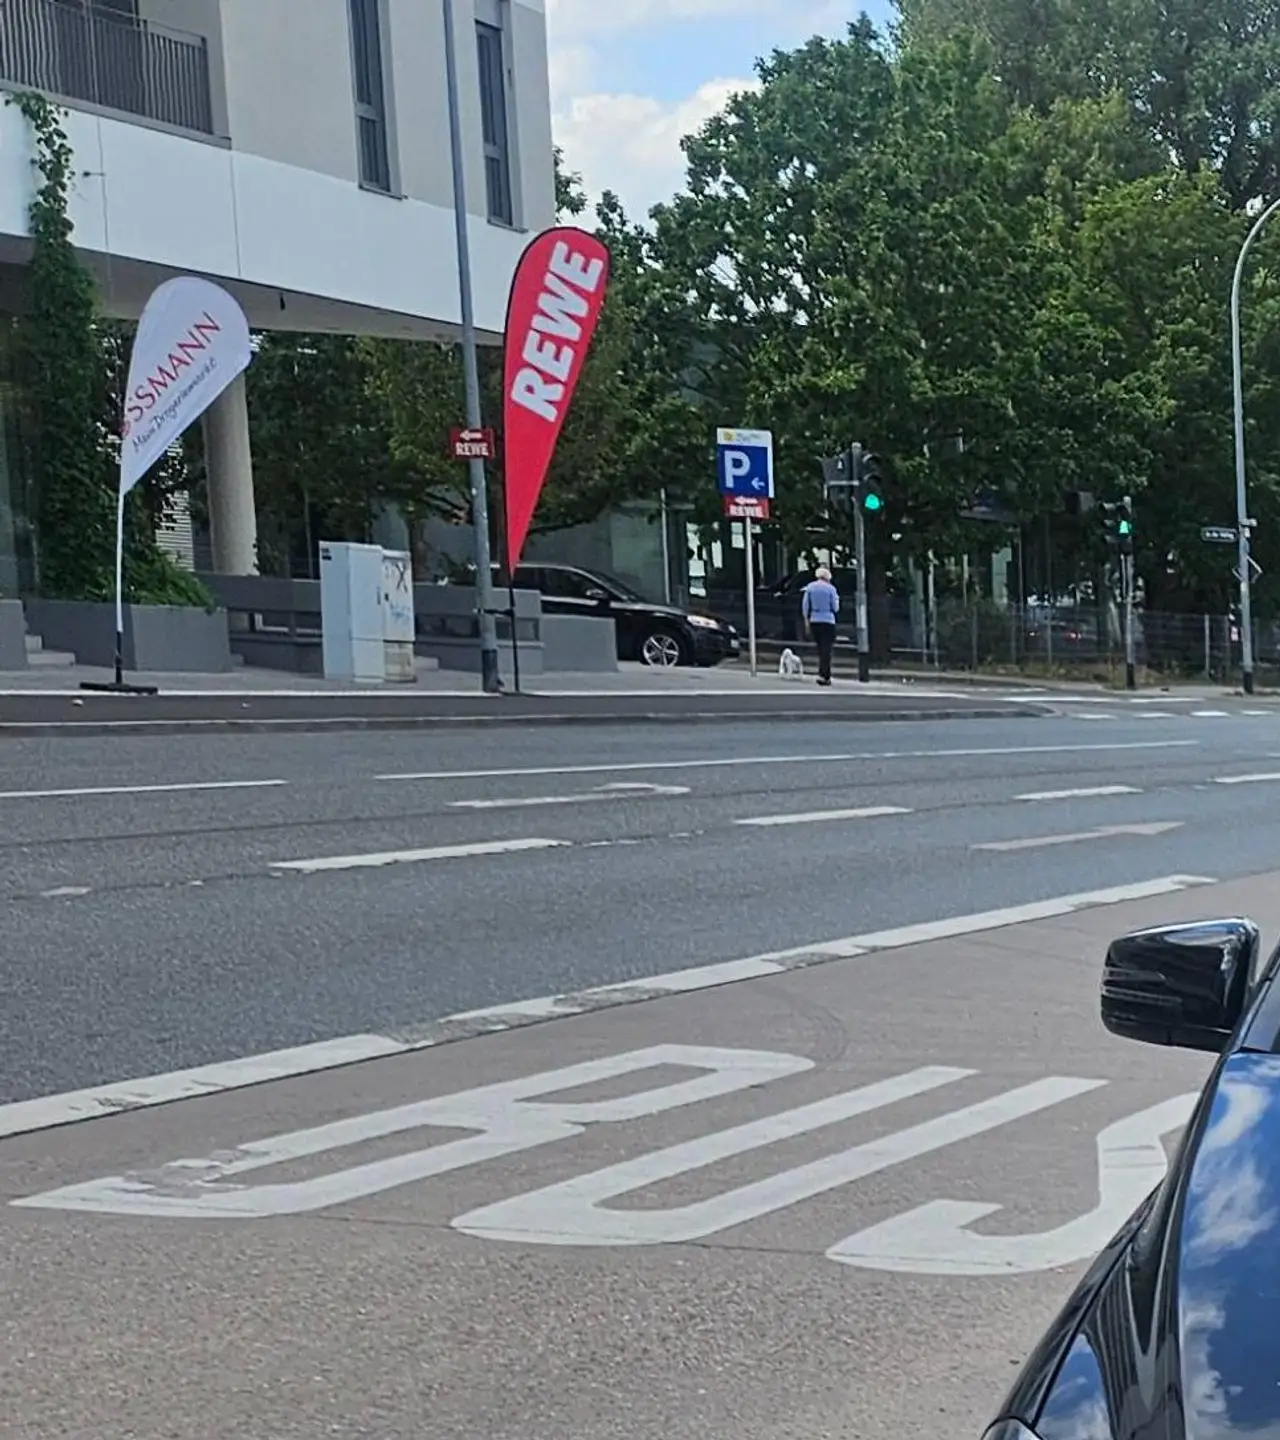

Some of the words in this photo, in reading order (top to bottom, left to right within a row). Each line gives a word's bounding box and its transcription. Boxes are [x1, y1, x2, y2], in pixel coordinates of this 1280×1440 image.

[510, 239, 604, 423] REWE
[455, 442, 490, 457] REWE
[724, 450, 751, 489] P
[8, 1043, 1200, 1276] BUS
